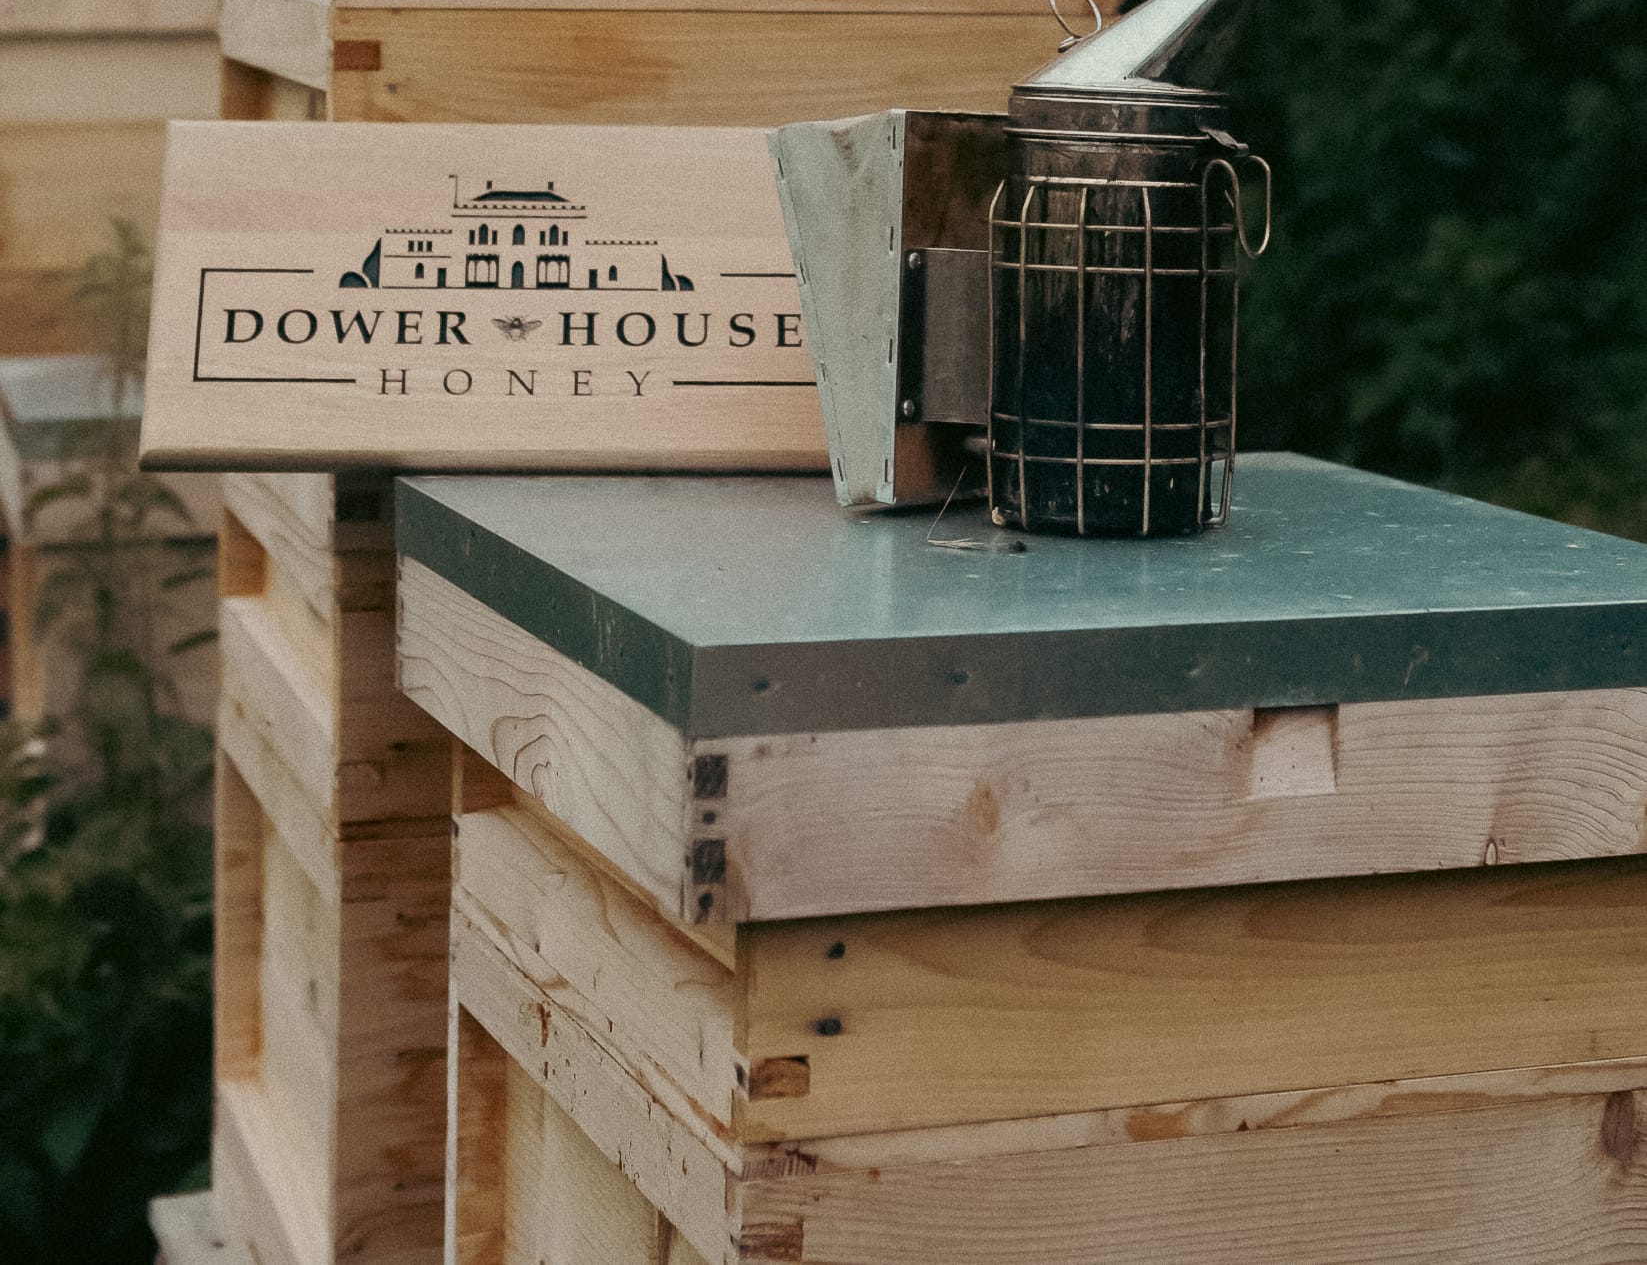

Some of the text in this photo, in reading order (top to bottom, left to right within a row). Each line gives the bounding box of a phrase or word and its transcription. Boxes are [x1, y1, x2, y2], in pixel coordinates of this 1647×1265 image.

[223, 308, 803, 348] DOWER HOUSE
[378, 369, 653, 397] HONEY
